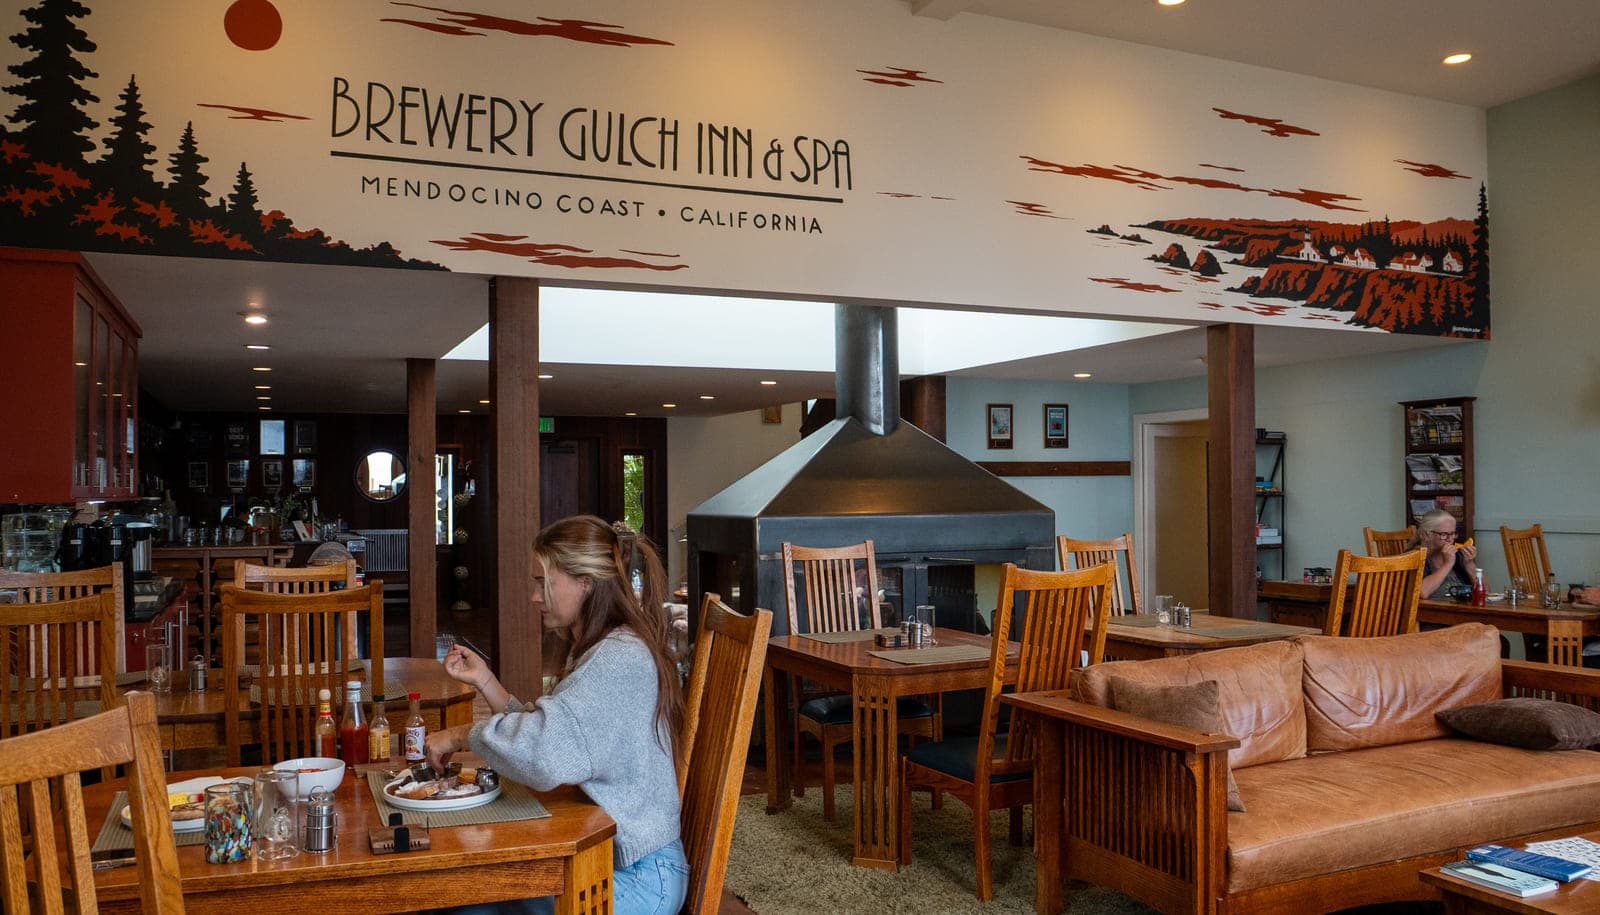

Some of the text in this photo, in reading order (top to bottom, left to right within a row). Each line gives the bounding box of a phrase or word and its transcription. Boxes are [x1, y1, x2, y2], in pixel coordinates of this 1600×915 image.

[331, 76, 853, 191] BREWERY GULCH INN & SPA
[361, 175, 823, 234] MENDOCINO COAST CALIFORNIA
